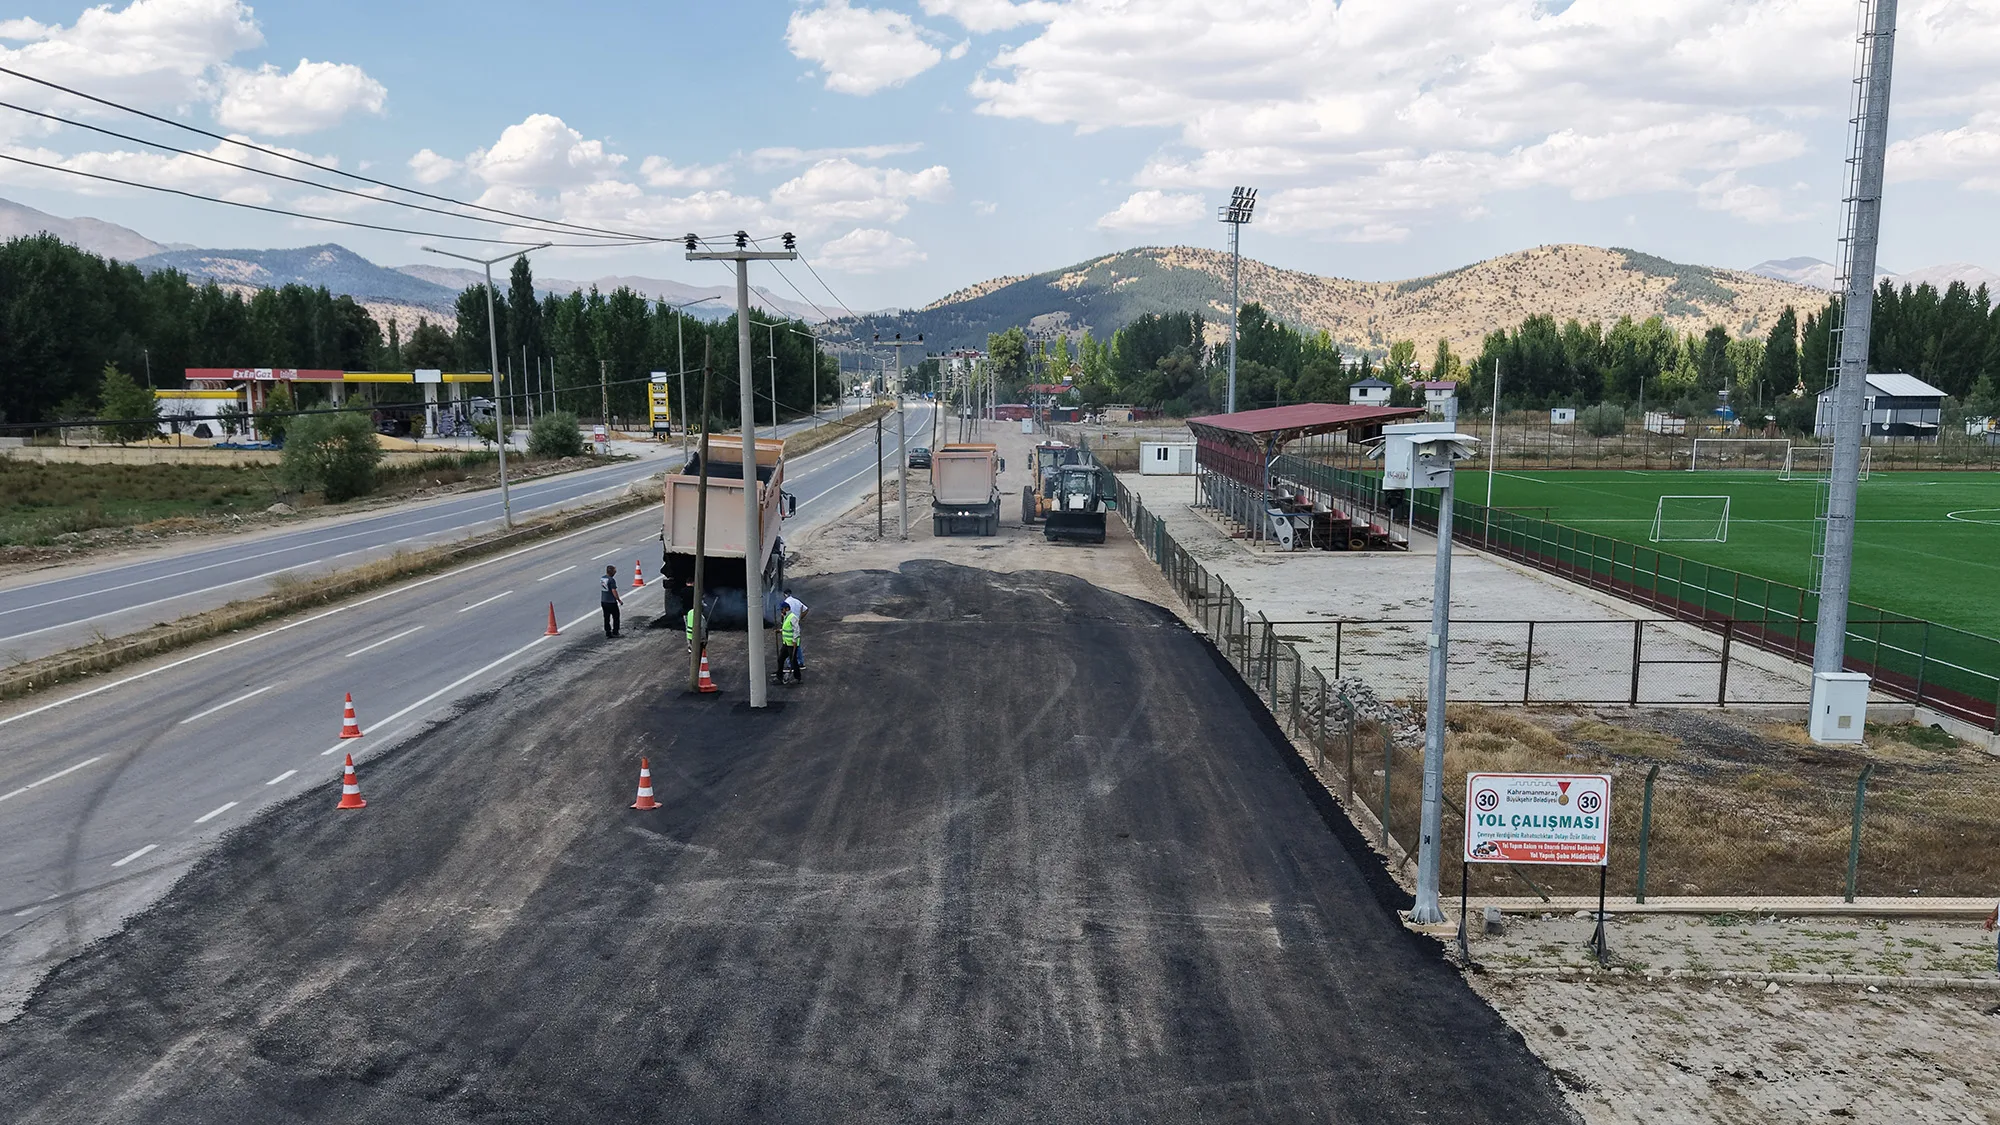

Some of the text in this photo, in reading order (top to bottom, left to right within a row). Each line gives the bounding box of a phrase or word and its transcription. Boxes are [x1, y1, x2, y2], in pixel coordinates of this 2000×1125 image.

[1507, 789, 1558, 797] Kahramanmaraş
[1478, 794, 1496, 807] 30
[1581, 796, 1597, 809] 30
[1476, 813, 1600, 831] YOL ÇALIŞMASI
[1539, 852, 1556, 860] Yapım
